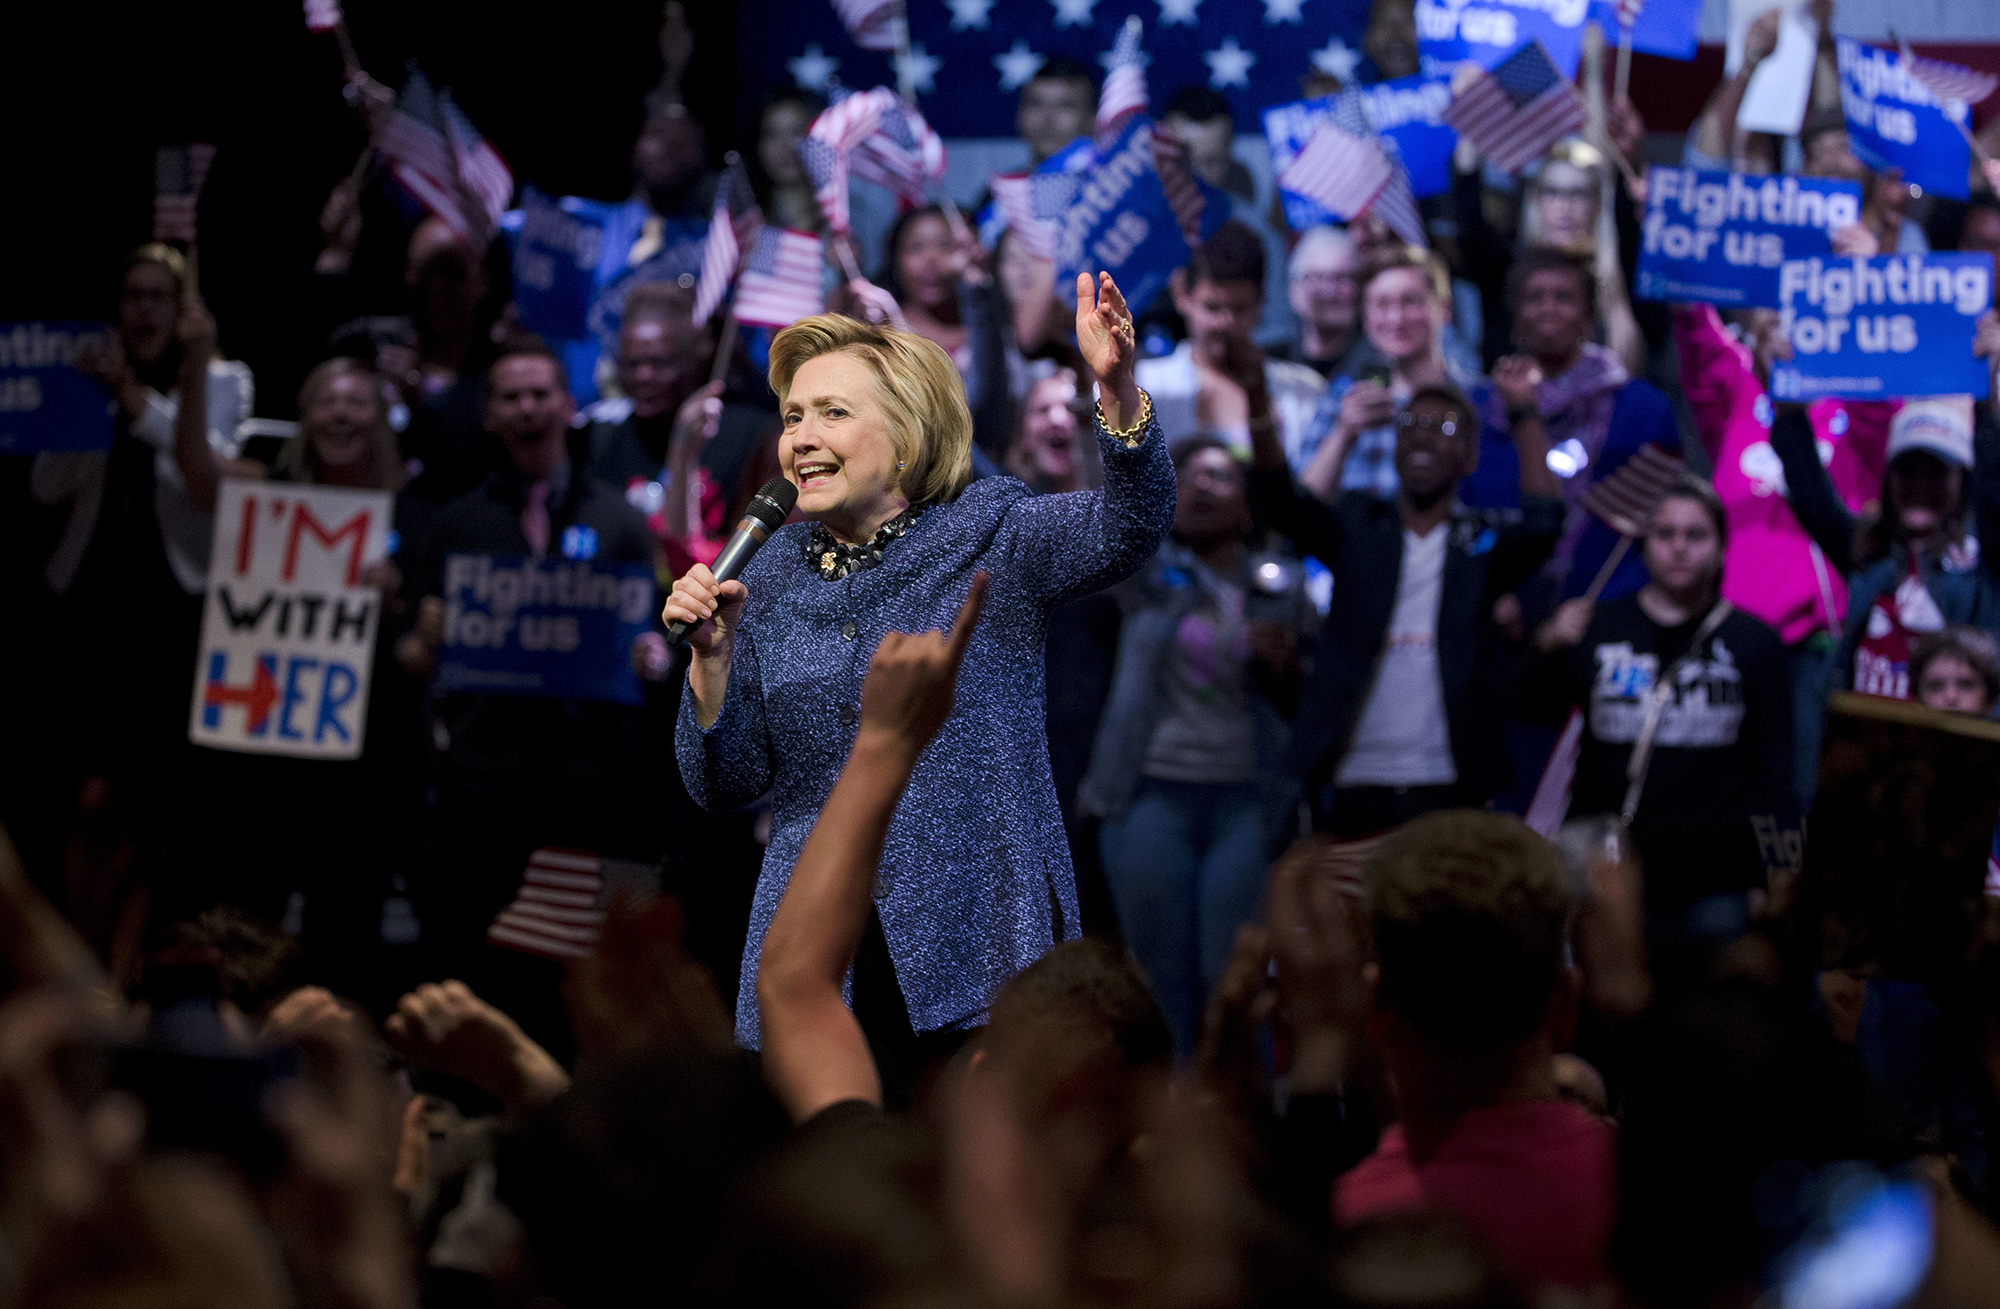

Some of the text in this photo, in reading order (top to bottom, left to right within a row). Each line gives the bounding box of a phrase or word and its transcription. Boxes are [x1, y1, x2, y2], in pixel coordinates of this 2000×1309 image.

[1652, 168, 1859, 237] Fighting
[1645, 207, 1784, 267] for us
[1780, 254, 1990, 316] Fighting
[1856, 315, 1917, 353] us
[238, 496, 373, 587] I'M
[218, 585, 370, 642] WITH
[446, 553, 652, 624] Fighting
[519, 614, 580, 650] us
[203, 651, 360, 739] HER
